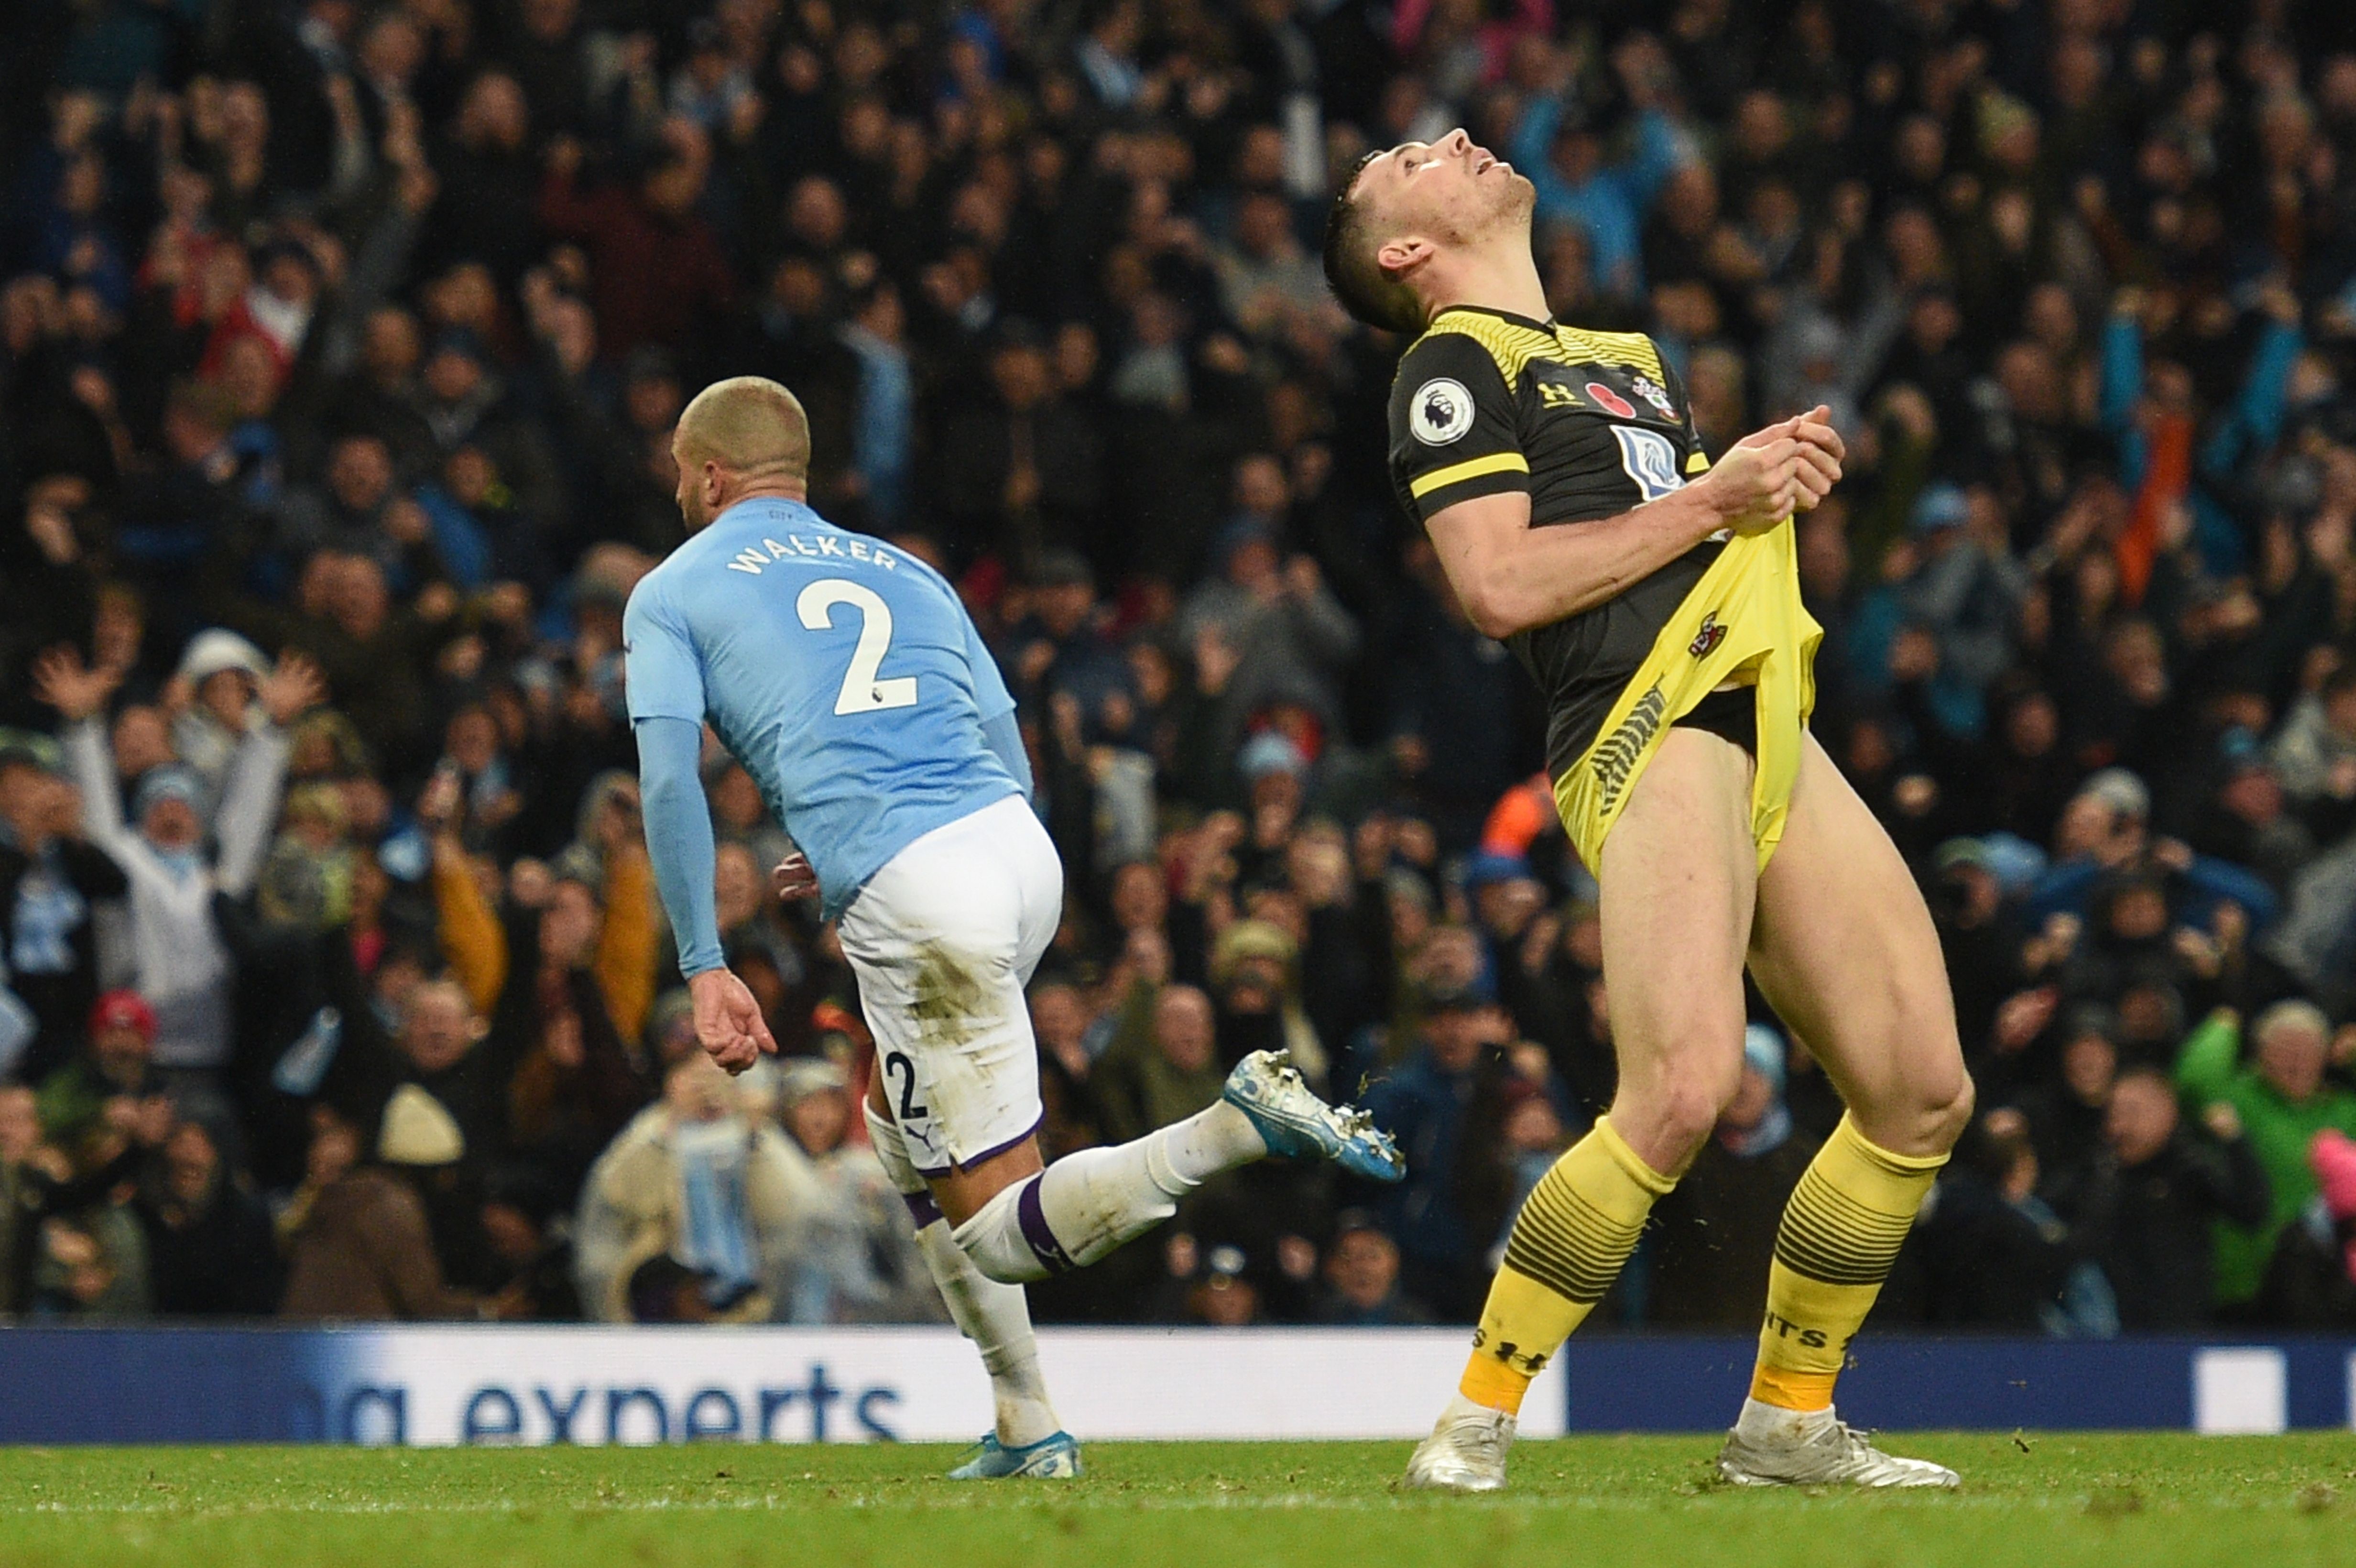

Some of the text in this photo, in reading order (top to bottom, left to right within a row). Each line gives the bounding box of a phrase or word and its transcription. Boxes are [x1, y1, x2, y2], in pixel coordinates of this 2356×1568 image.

[728, 534, 897, 575] WALKER
[796, 579, 917, 716] 2
[885, 1052, 927, 1119] 2
[463, 1362, 900, 1444] experts
